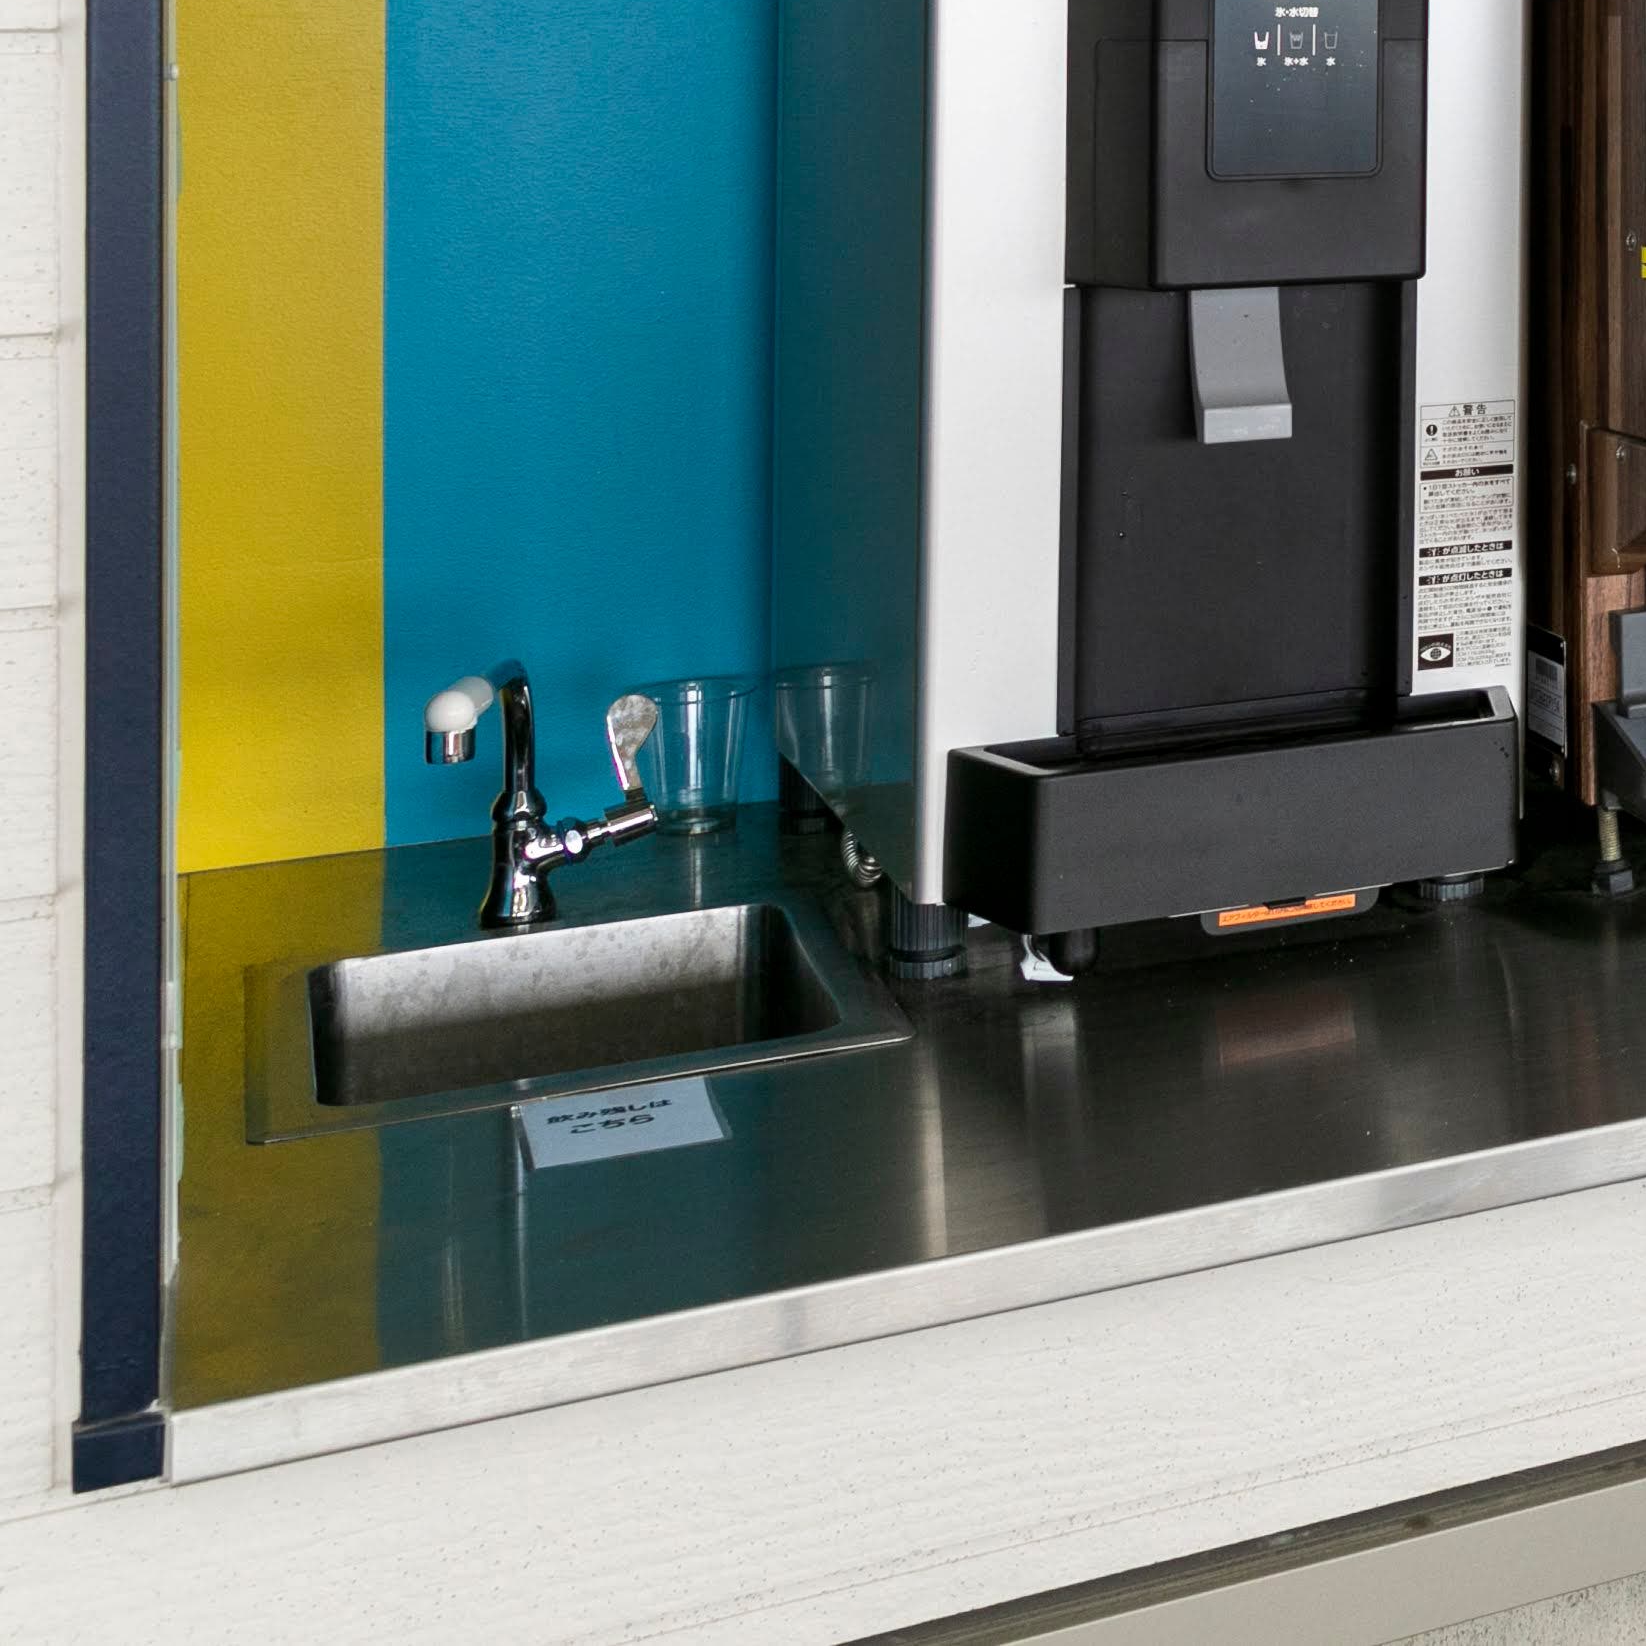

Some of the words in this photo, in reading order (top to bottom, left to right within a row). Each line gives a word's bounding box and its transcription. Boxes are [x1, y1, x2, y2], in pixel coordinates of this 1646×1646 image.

[1463, 404, 1487, 416] 警告
[1454, 468, 1480, 478] お願い
[1442, 542, 1505, 555] が点滅したときは
[1442, 570, 1505, 583] が点灯したときは
[546, 1098, 673, 1125] 飲み残しは
[570, 1113, 656, 1134] こちら
